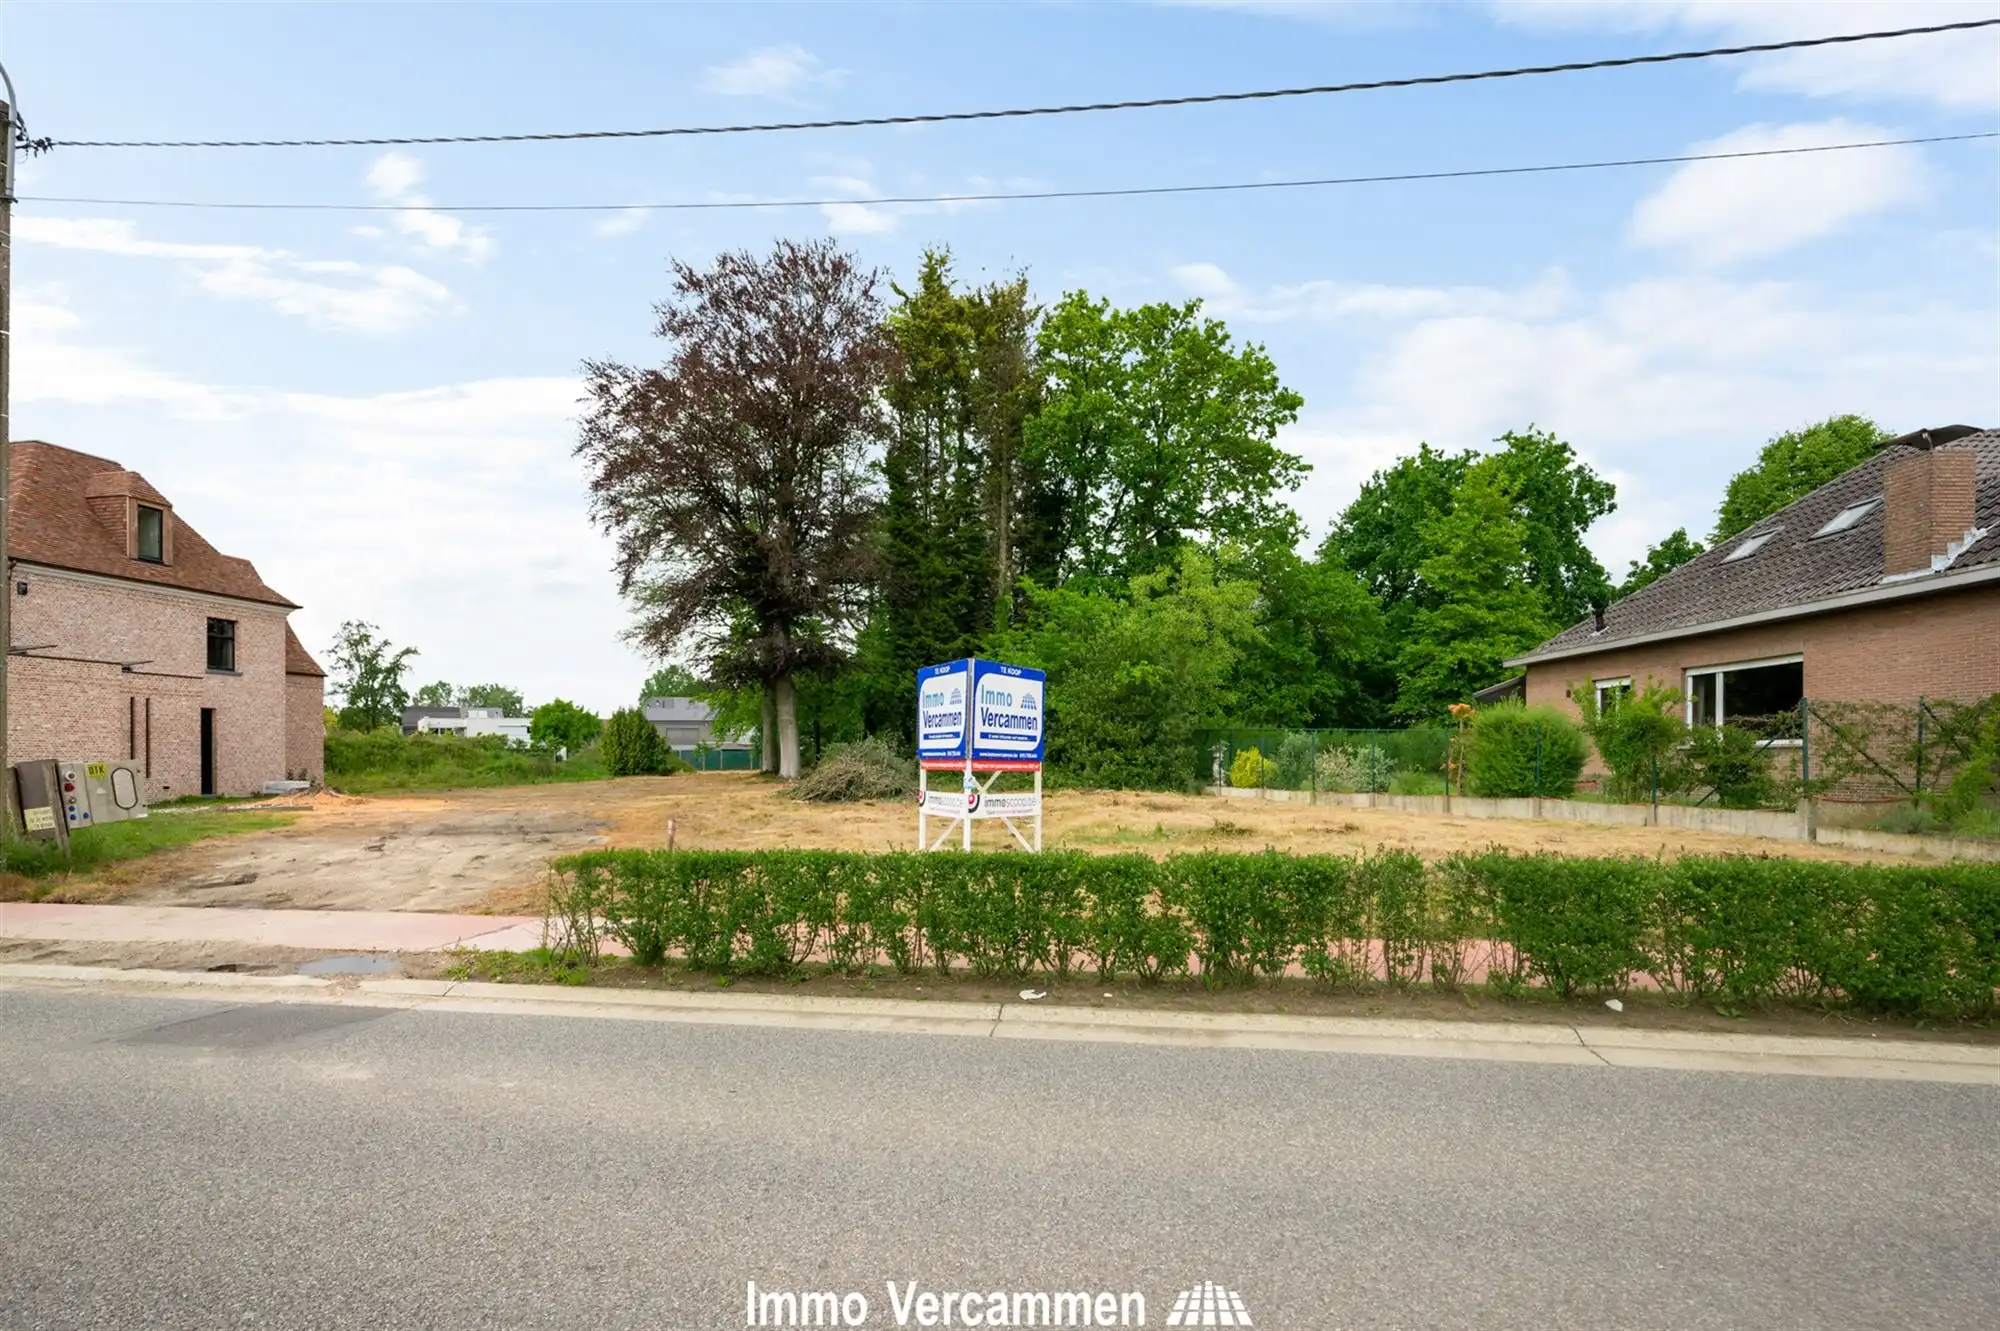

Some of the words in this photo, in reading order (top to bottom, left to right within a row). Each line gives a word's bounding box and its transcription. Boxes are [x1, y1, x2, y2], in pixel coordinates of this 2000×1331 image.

[1000, 666, 1007, 674] TE
[1007, 668, 1022, 676] KOOP
[923, 691, 944, 708] Immo
[981, 684, 1013, 707] Immo
[923, 710, 962, 728] Vercammen
[981, 707, 1038, 730] Vercammen
